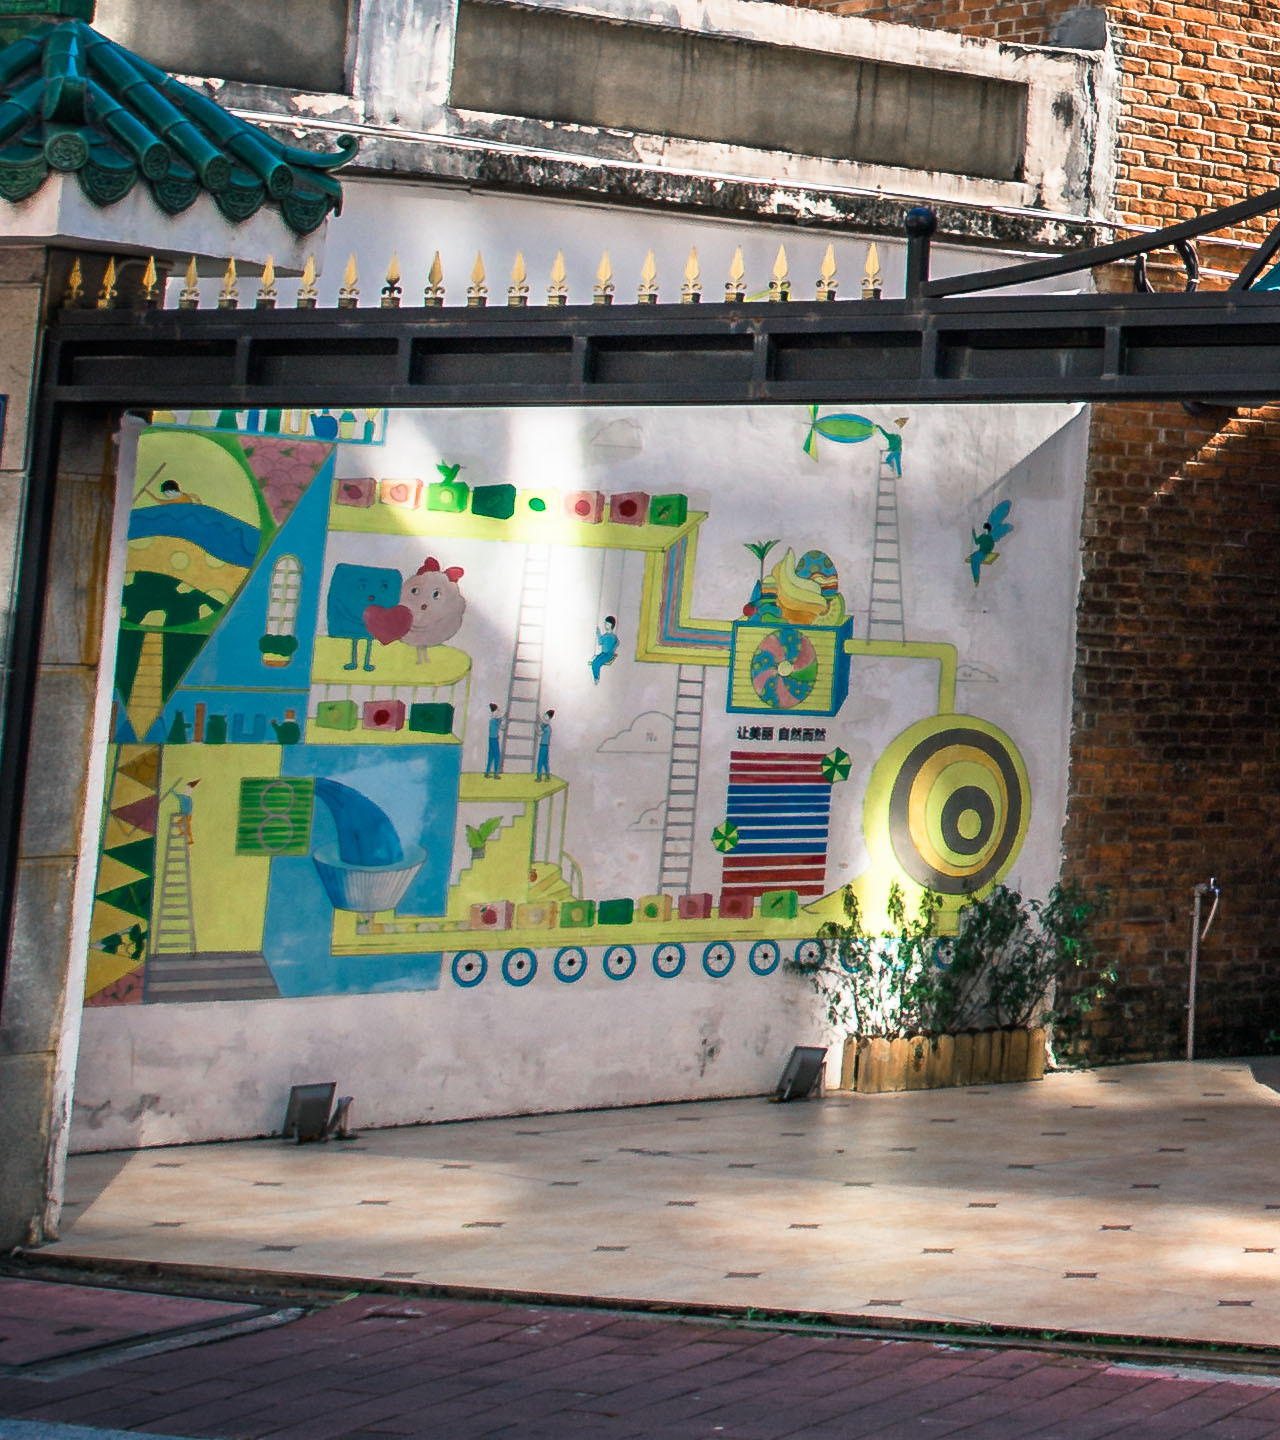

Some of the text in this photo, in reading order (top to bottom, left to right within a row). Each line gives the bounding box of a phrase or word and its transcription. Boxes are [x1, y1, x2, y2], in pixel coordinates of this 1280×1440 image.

[737, 726, 826, 741] 让美丽 自然而然
